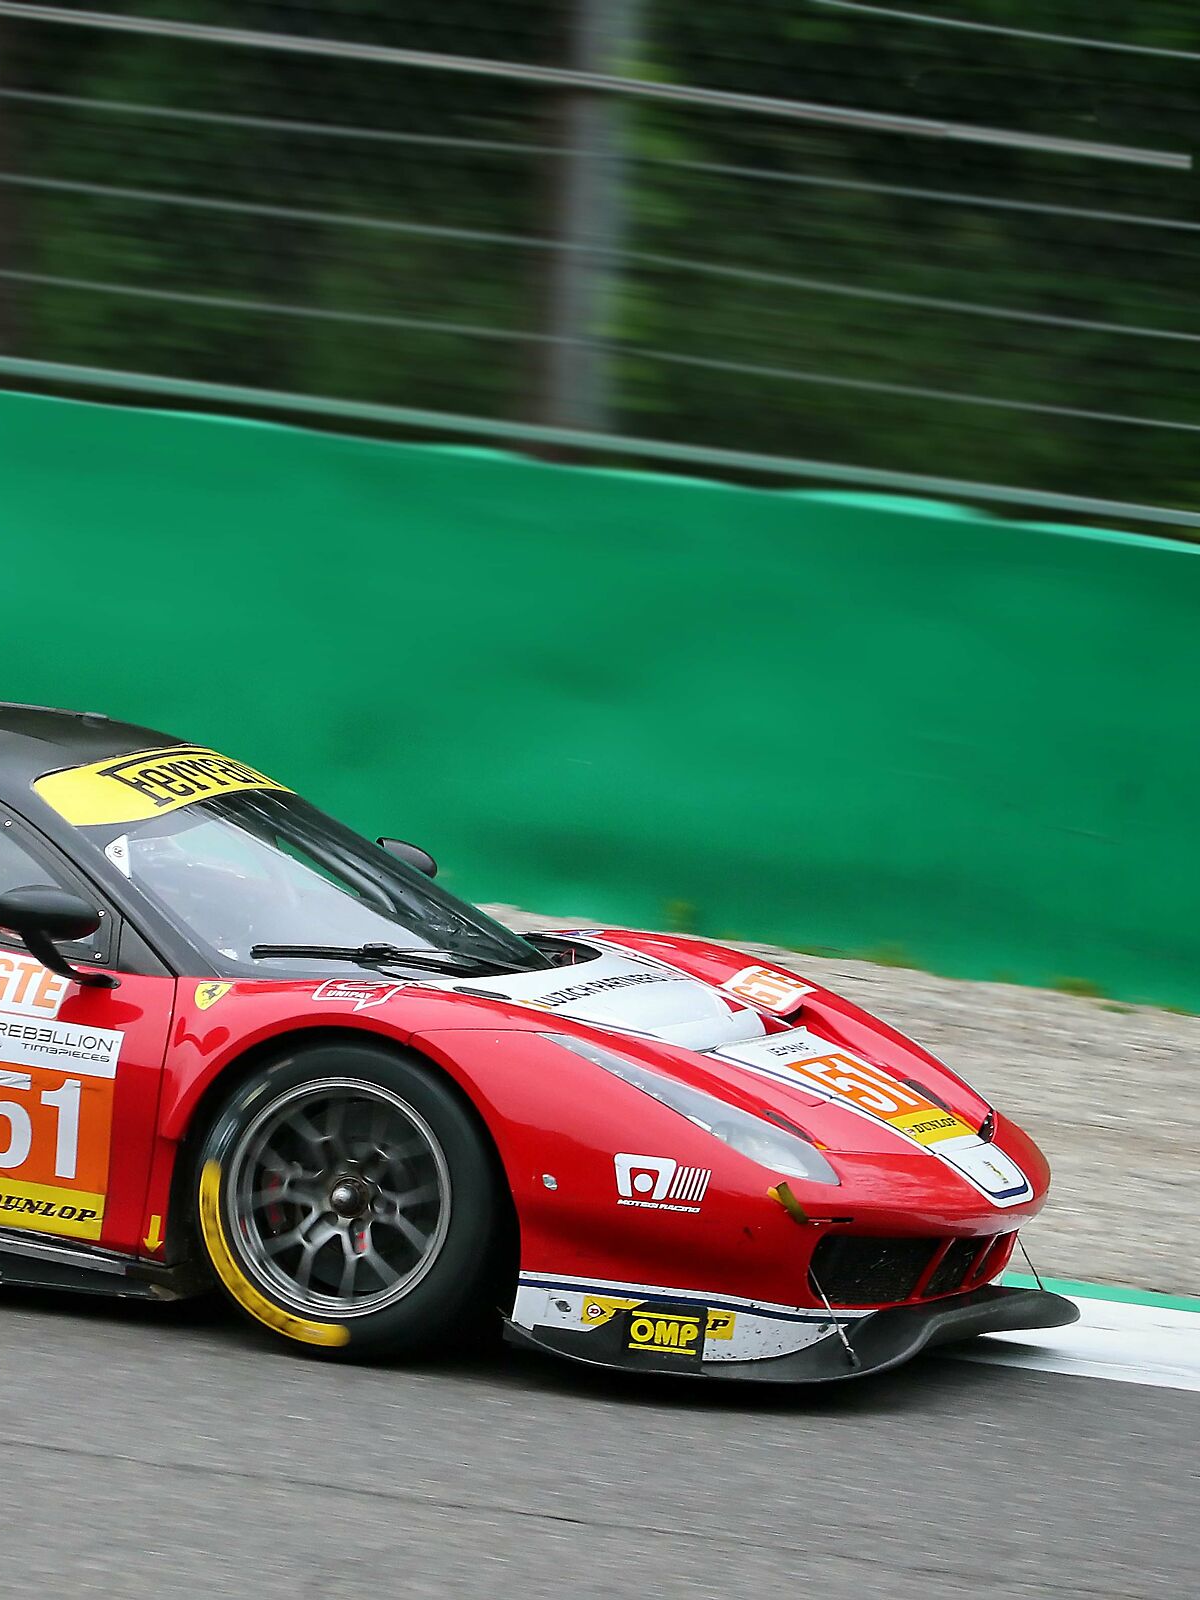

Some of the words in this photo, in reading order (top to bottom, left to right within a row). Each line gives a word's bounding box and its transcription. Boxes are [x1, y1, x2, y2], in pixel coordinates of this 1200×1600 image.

[326, 989, 375, 1000] UNIPAY
[732, 970, 806, 1006] GTE
[801, 1057, 920, 1113] 51
[912, 1117, 958, 1133] DUNLOP
[629, 1317, 699, 1347] OMP
